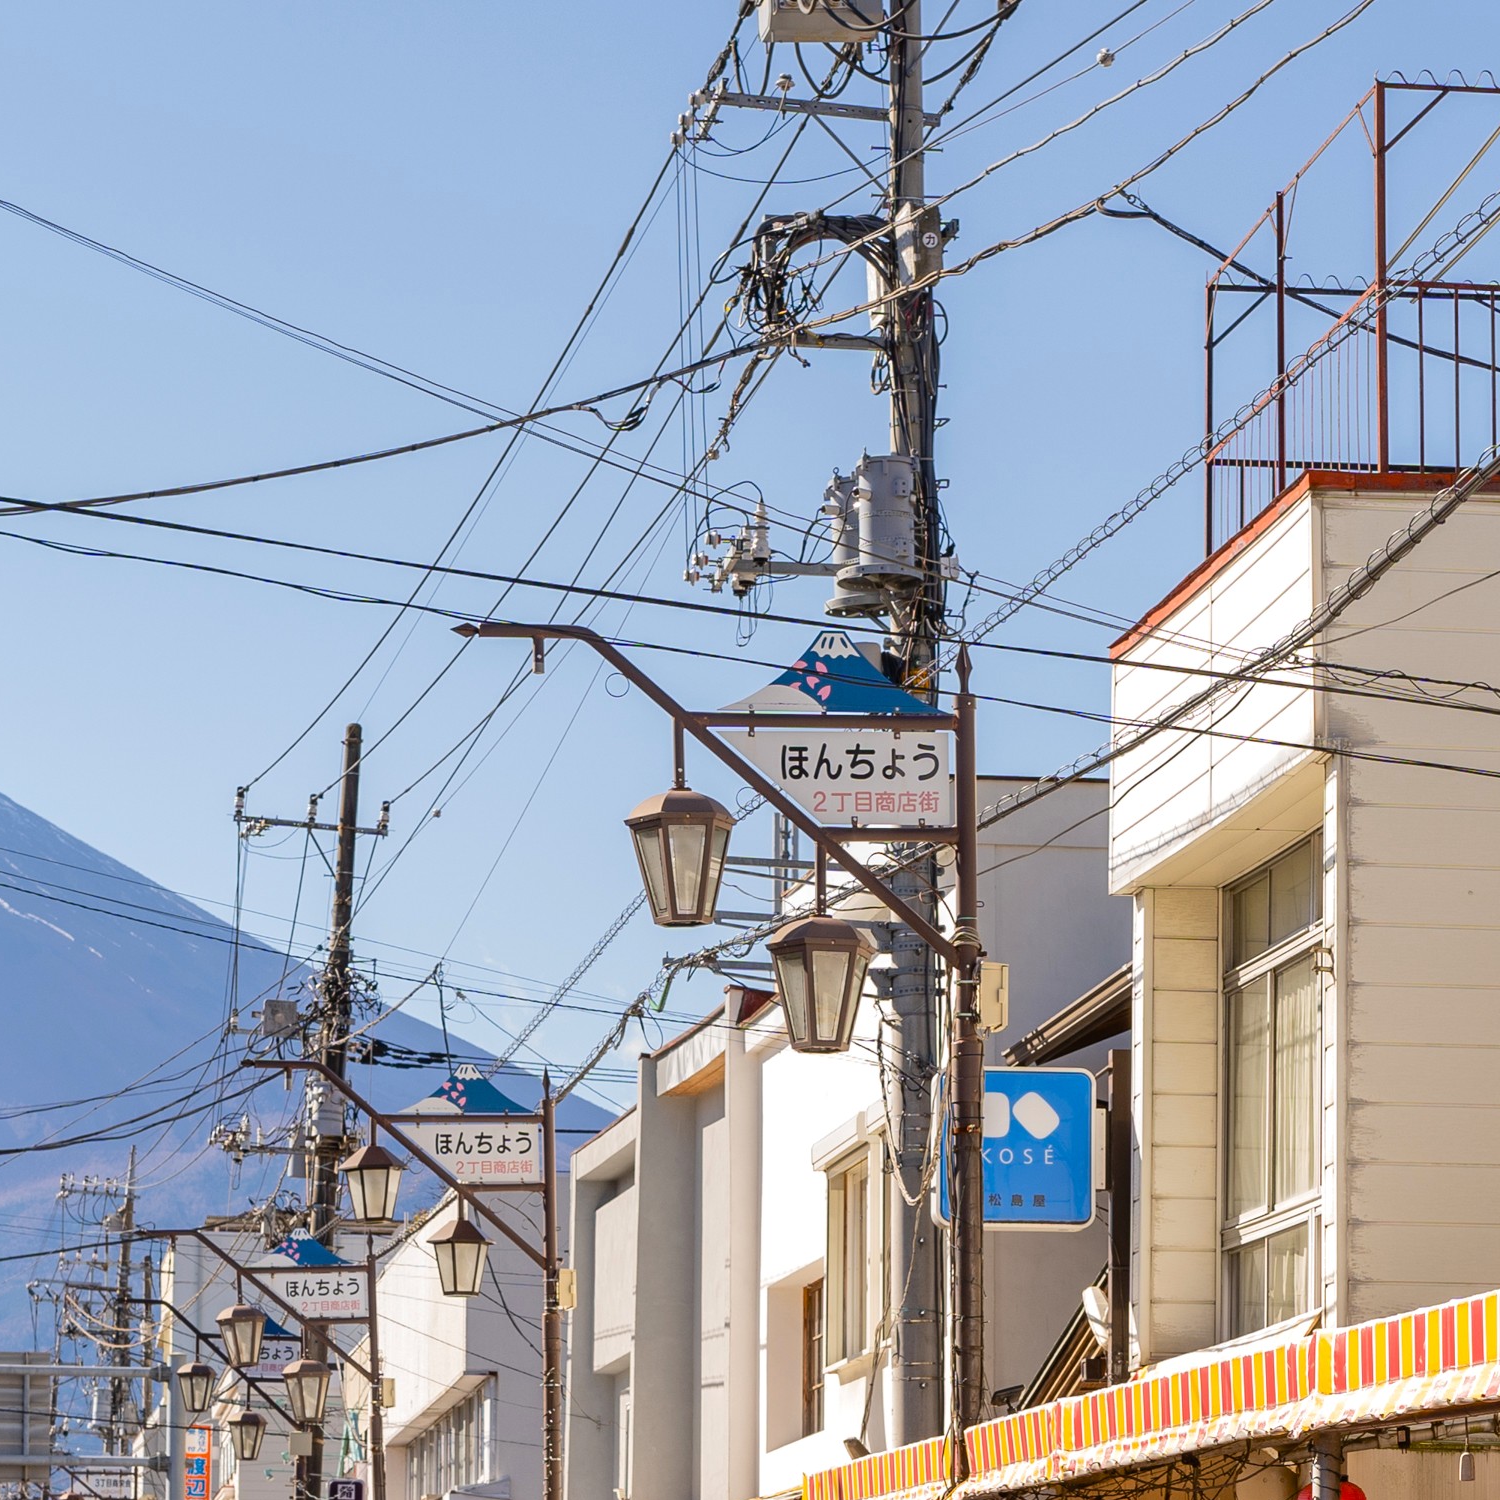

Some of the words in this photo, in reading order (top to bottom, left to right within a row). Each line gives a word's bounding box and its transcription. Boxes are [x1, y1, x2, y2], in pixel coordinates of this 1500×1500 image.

[781, 743, 939, 781] ほんちょう
[813, 791, 940, 813] 2丁目商店街
[436, 1131, 532, 1155] ほんちょう
[981, 1144, 1054, 1164] KOSÉ
[456, 1160, 533, 1175] 2丁目商店街
[988, 1193, 1045, 1207] 松島屋
[286, 1278, 360, 1297] ほんちょう
